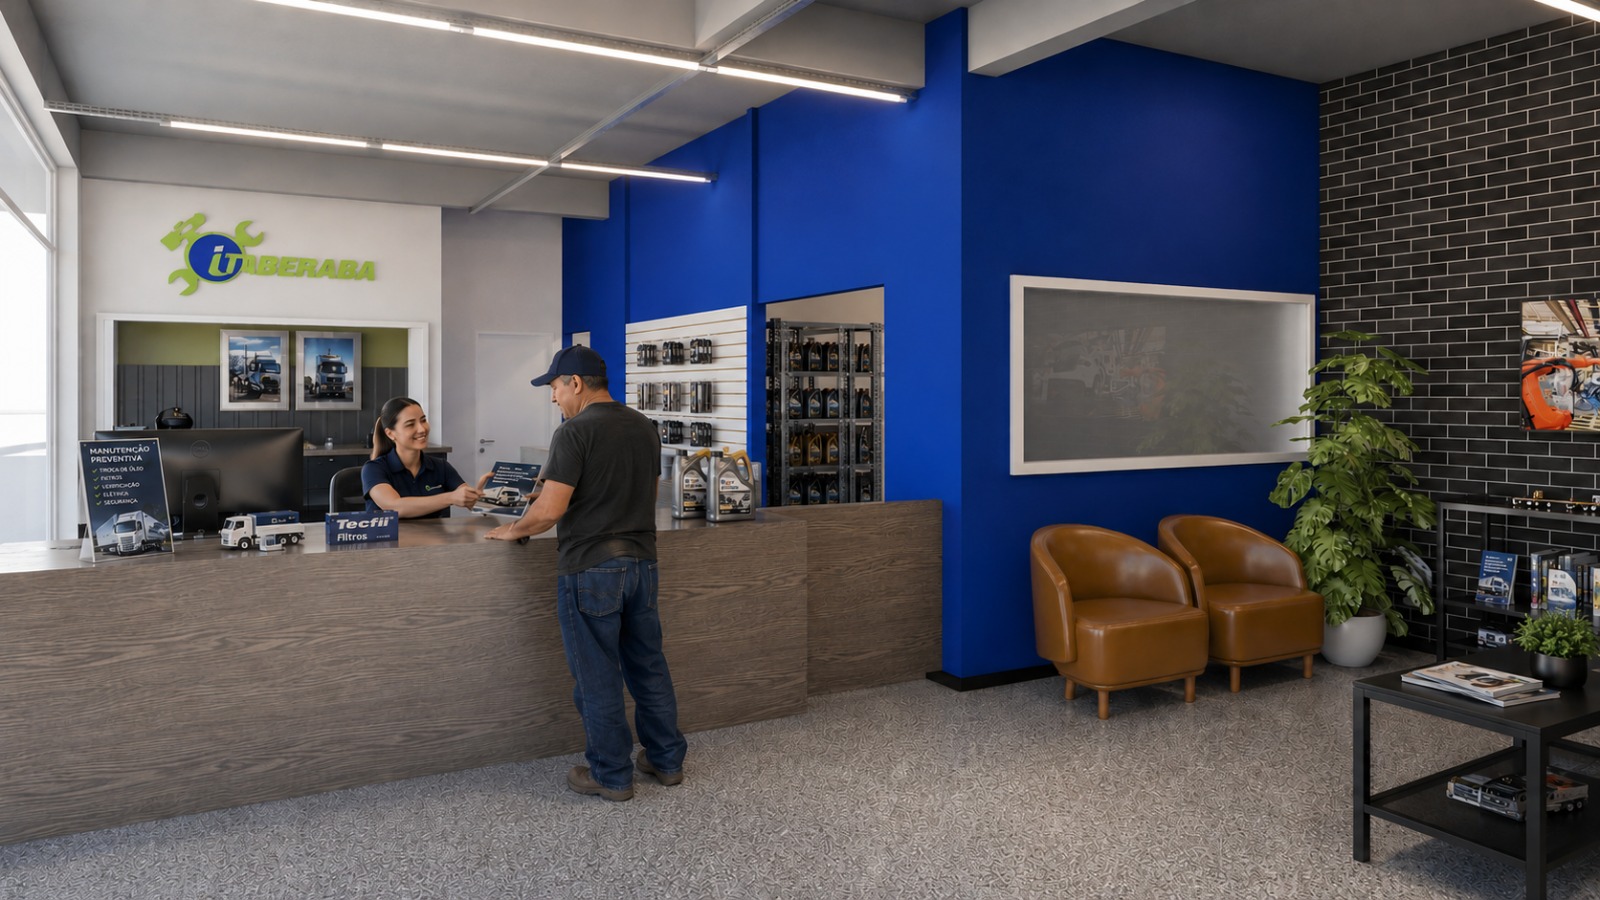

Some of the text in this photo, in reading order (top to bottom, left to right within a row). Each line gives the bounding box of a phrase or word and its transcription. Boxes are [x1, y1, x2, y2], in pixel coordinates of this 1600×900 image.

[89, 443, 150, 455] MANUTENÇÃO
[90, 454, 143, 463] PREVENTIVA
[337, 533, 368, 541] Filtros
